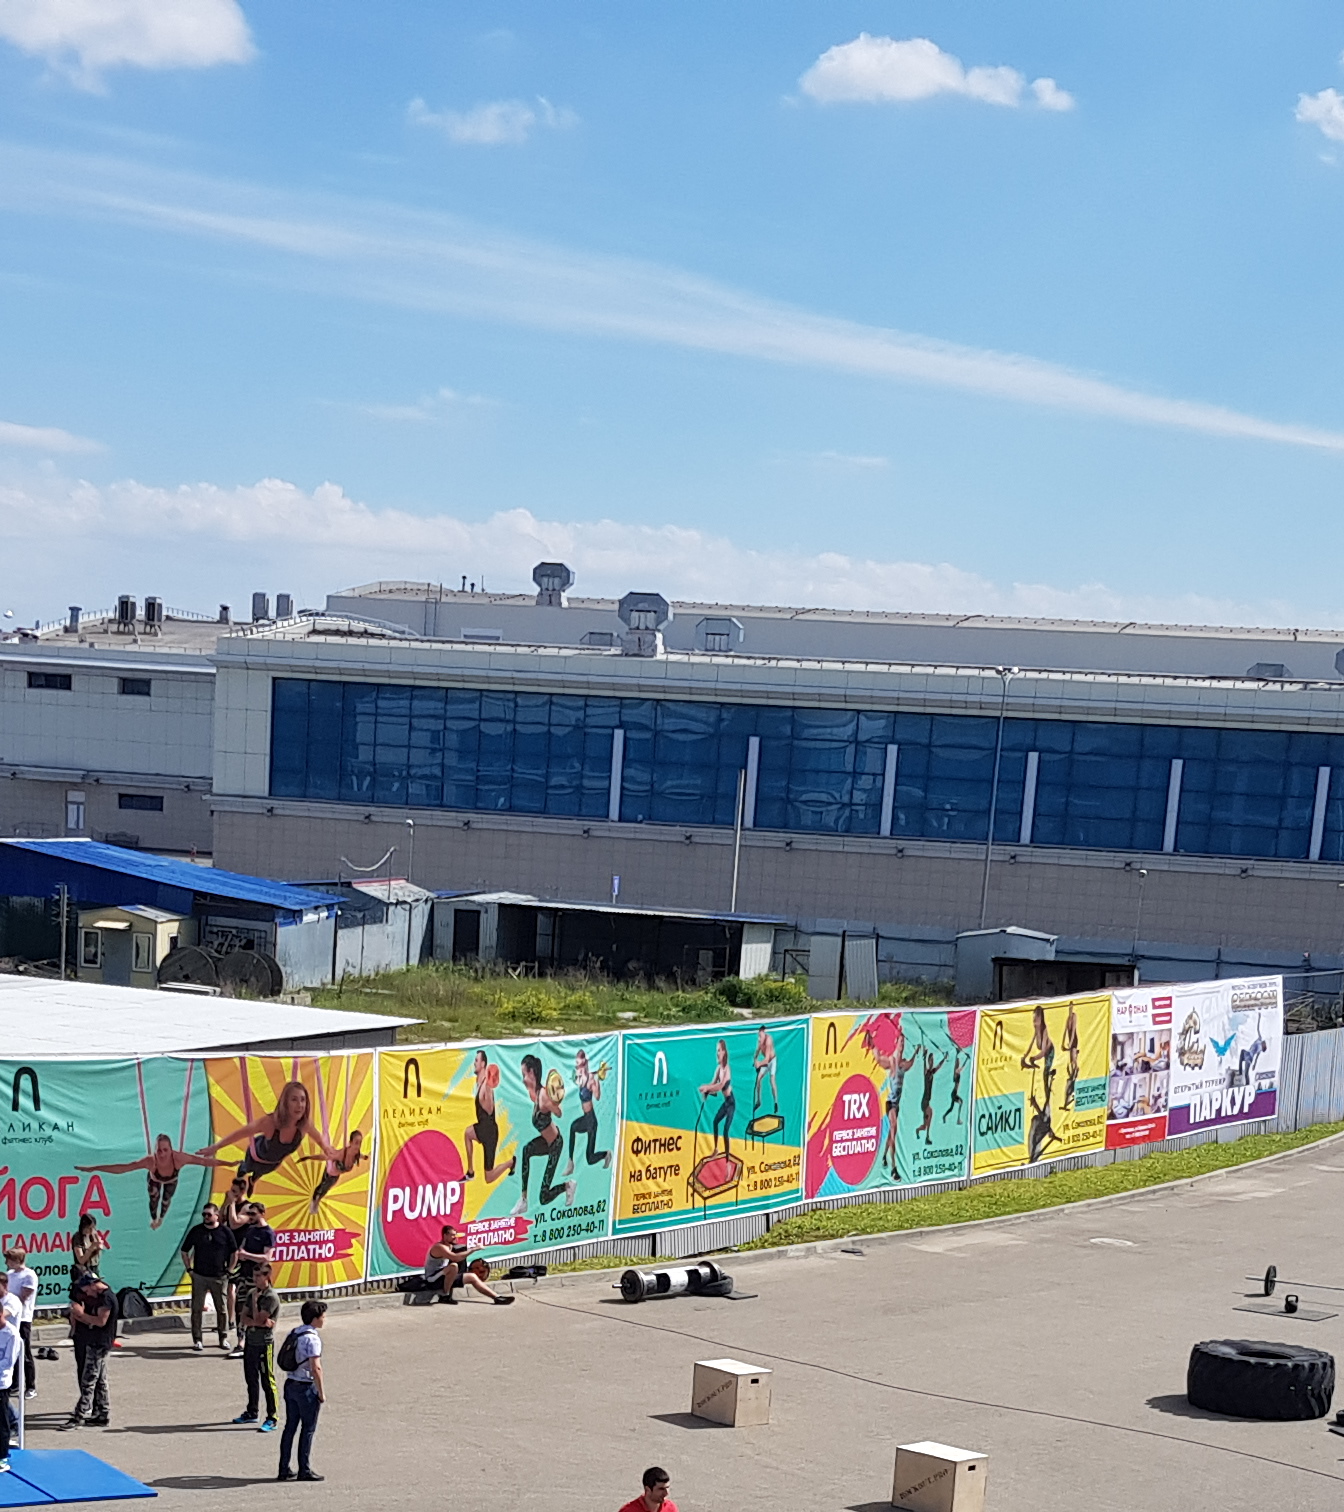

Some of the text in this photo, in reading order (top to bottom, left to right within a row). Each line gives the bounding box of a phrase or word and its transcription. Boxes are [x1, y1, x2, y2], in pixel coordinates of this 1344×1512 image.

[383, 1105, 442, 1119] ПЕЛИКАН
[842, 1092, 870, 1120] TRX
[1189, 1085, 1256, 1124] ПАРКУР
[978, 1105, 1022, 1137] САЙКЛ
[631, 1135, 682, 1157] Фитнес
[832, 1138, 876, 1157] БЕСПЛАТНО
[629, 1163, 680, 1183] на батуте
[386, 1180, 461, 1223] PUMP
[632, 1199, 673, 1215] БЕСПЛАТНО
[467, 1220, 489, 1234] ПЕРВОЕ
[534, 1212, 547, 1228] ул.
[1, 1229, 111, 1254] ГАМАКХ
[293, 1229, 335, 1243] ЗАНЯТИЕ
[467, 1228, 514, 1248] БЕСПЛАТНО
[549, 1228, 564, 1241] 800
[271, 1242, 335, 1261] СПЛАТНО
